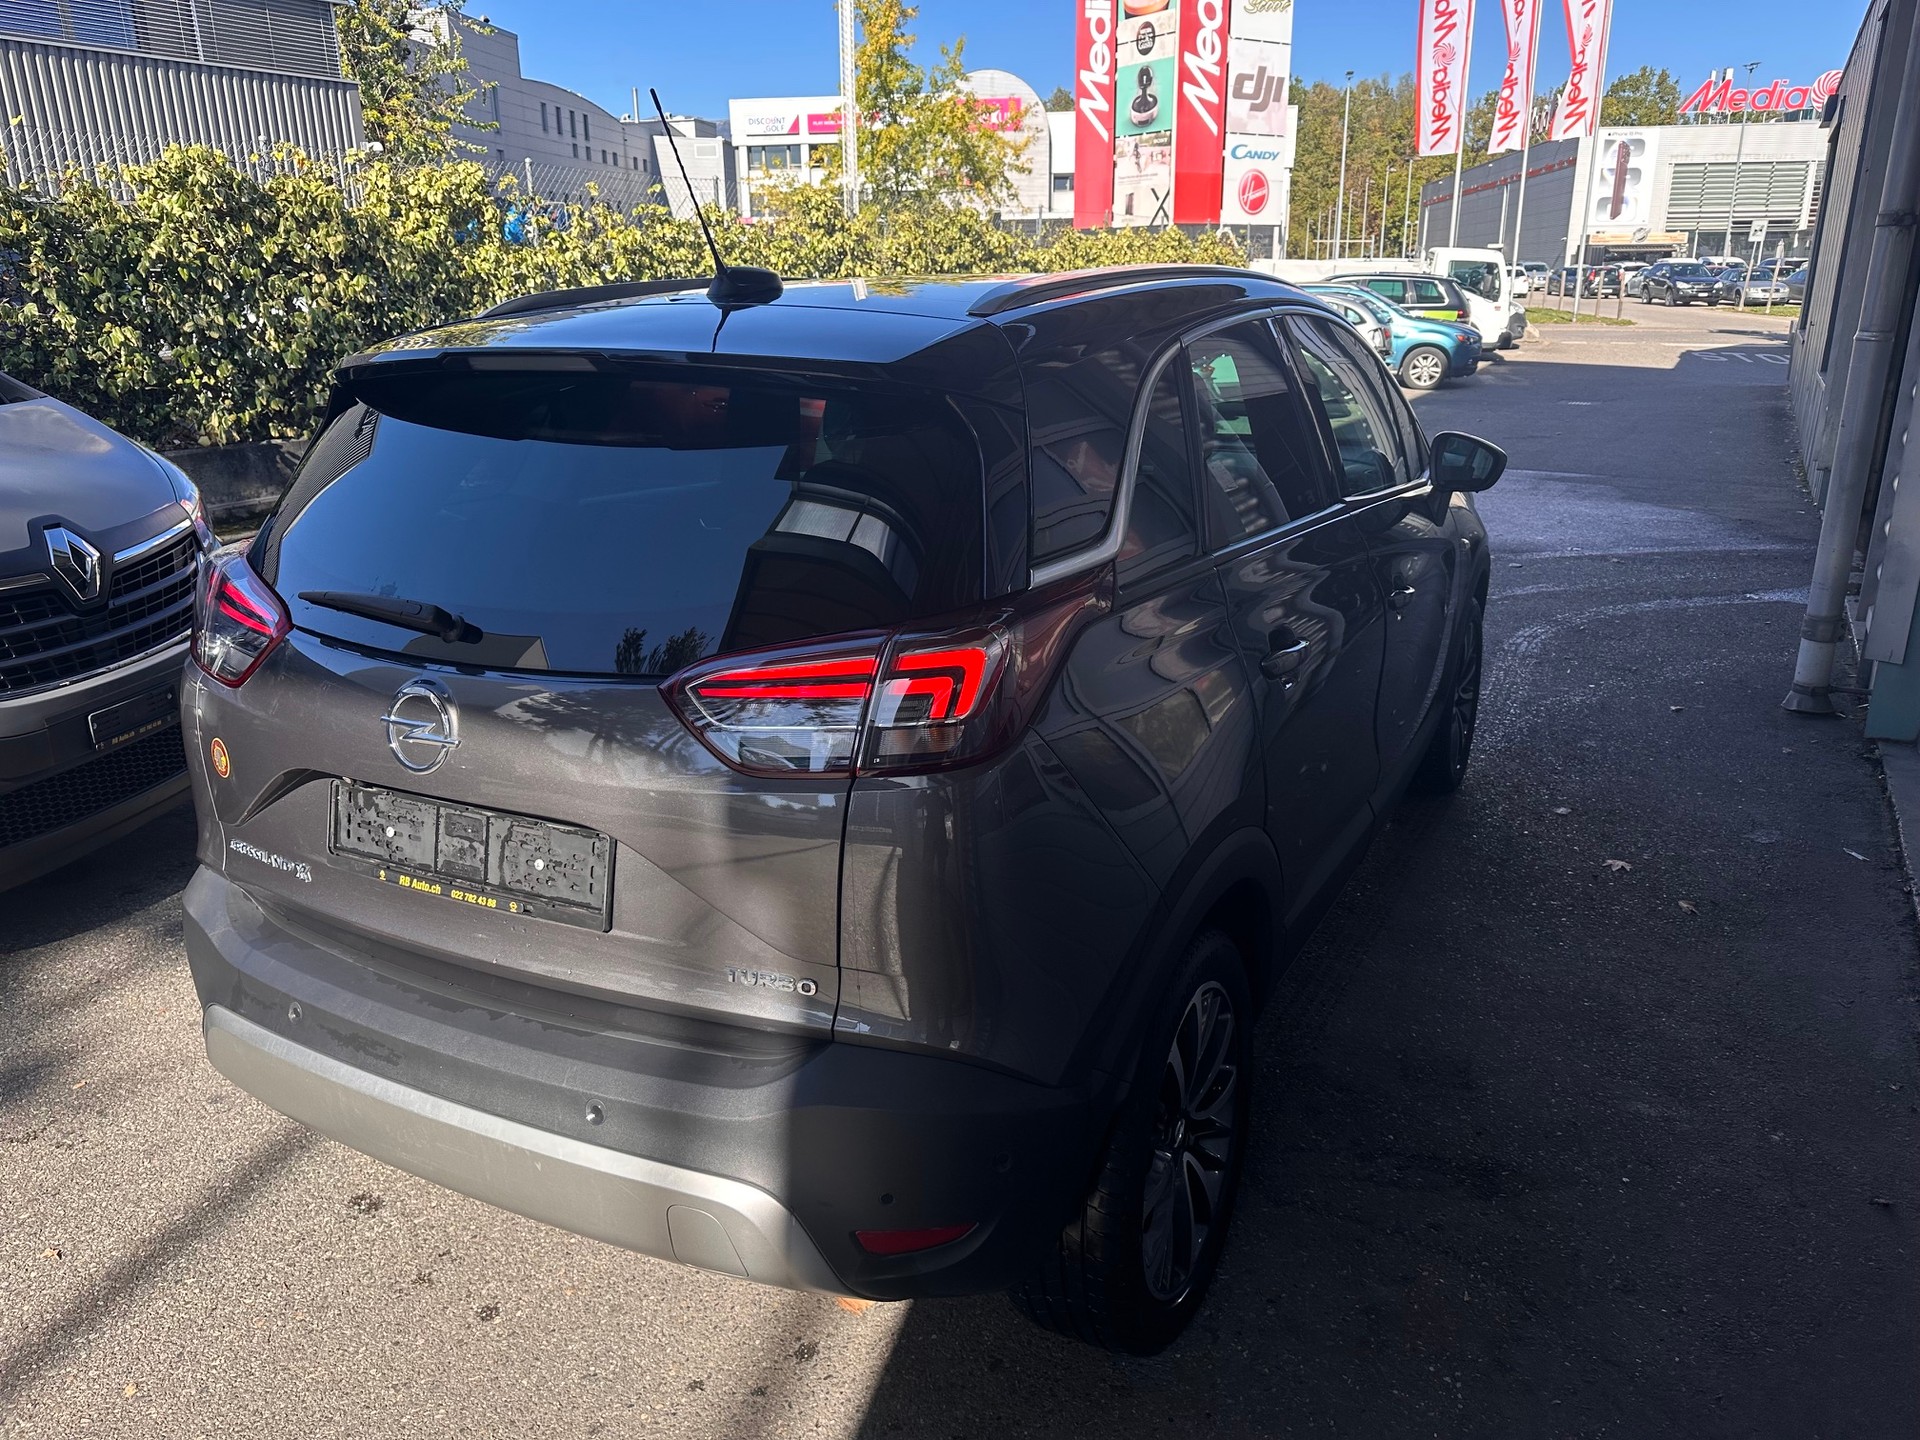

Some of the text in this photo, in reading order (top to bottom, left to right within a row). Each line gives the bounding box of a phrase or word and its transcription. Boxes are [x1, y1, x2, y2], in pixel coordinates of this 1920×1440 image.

[1679, 78, 1811, 114] Media
[748, 117, 785, 125] DISCOUNT
[399, 874, 411, 888] RB
[411, 878, 442, 895] Auto.ch
[450, 889, 463, 900] 022
[464, 893, 477, 904] 782
[477, 896, 487, 907] 43
[725, 965, 818, 997] TURBO
